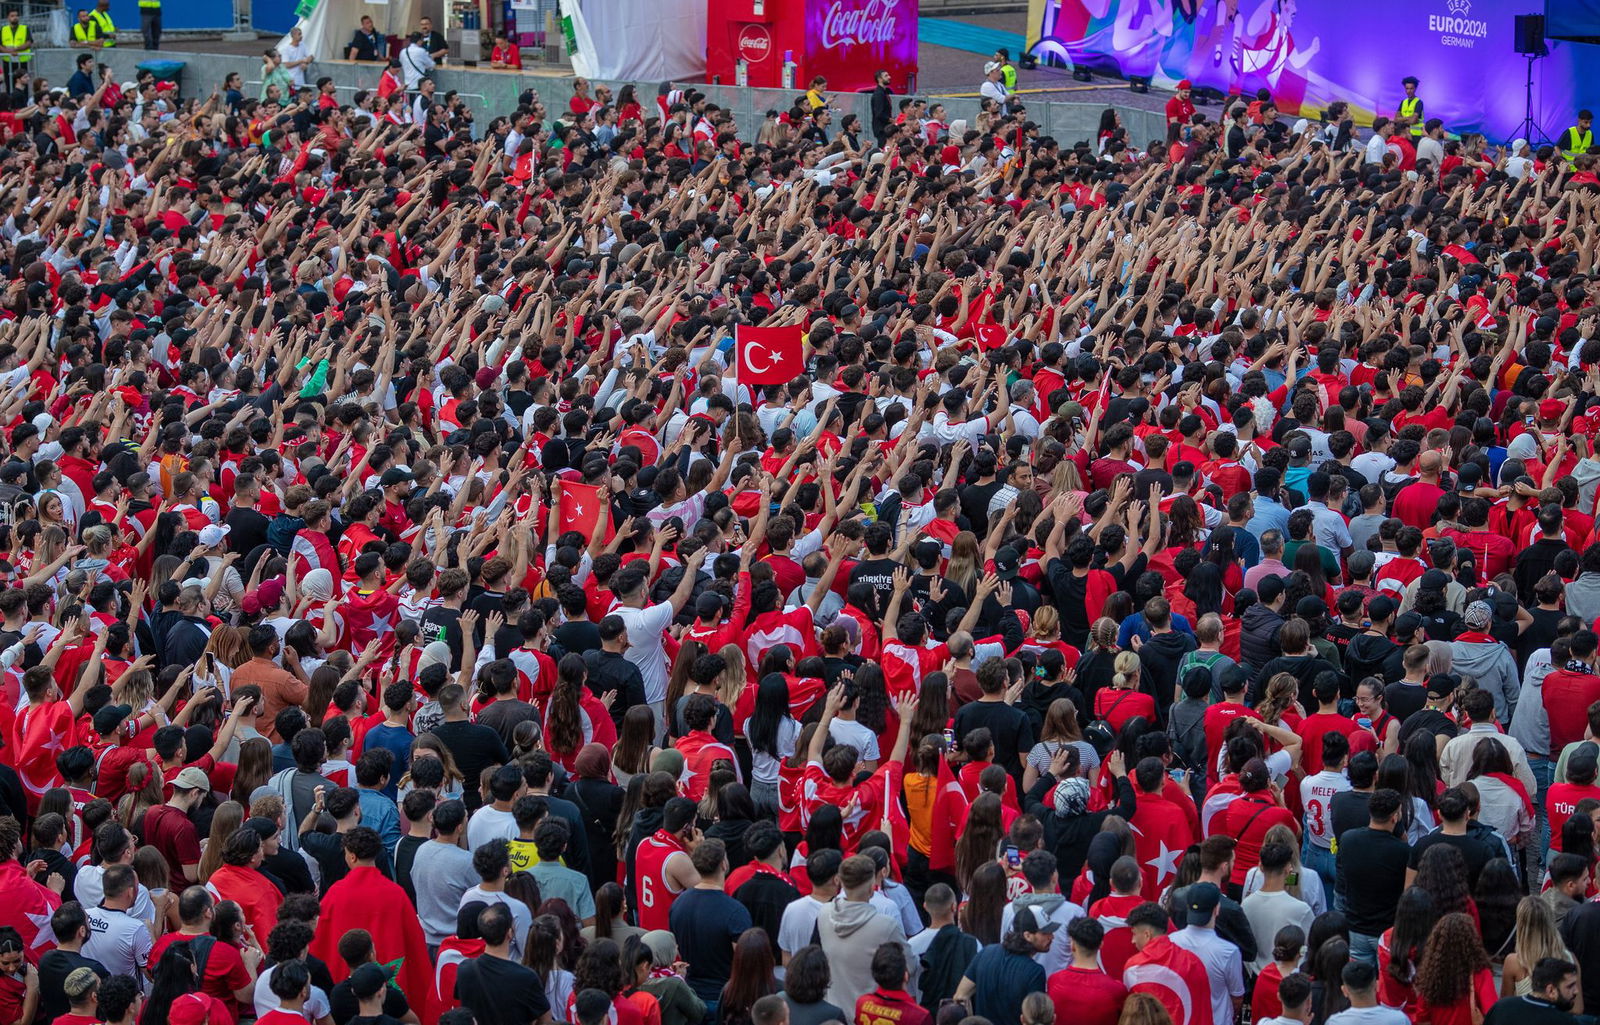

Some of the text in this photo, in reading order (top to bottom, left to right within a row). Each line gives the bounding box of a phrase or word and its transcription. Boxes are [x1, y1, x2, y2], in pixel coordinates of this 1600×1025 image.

[1448, 0, 1470, 14] UEFA
[1441, 35, 1474, 49] GERMANY
[642, 875, 654, 908] 6
